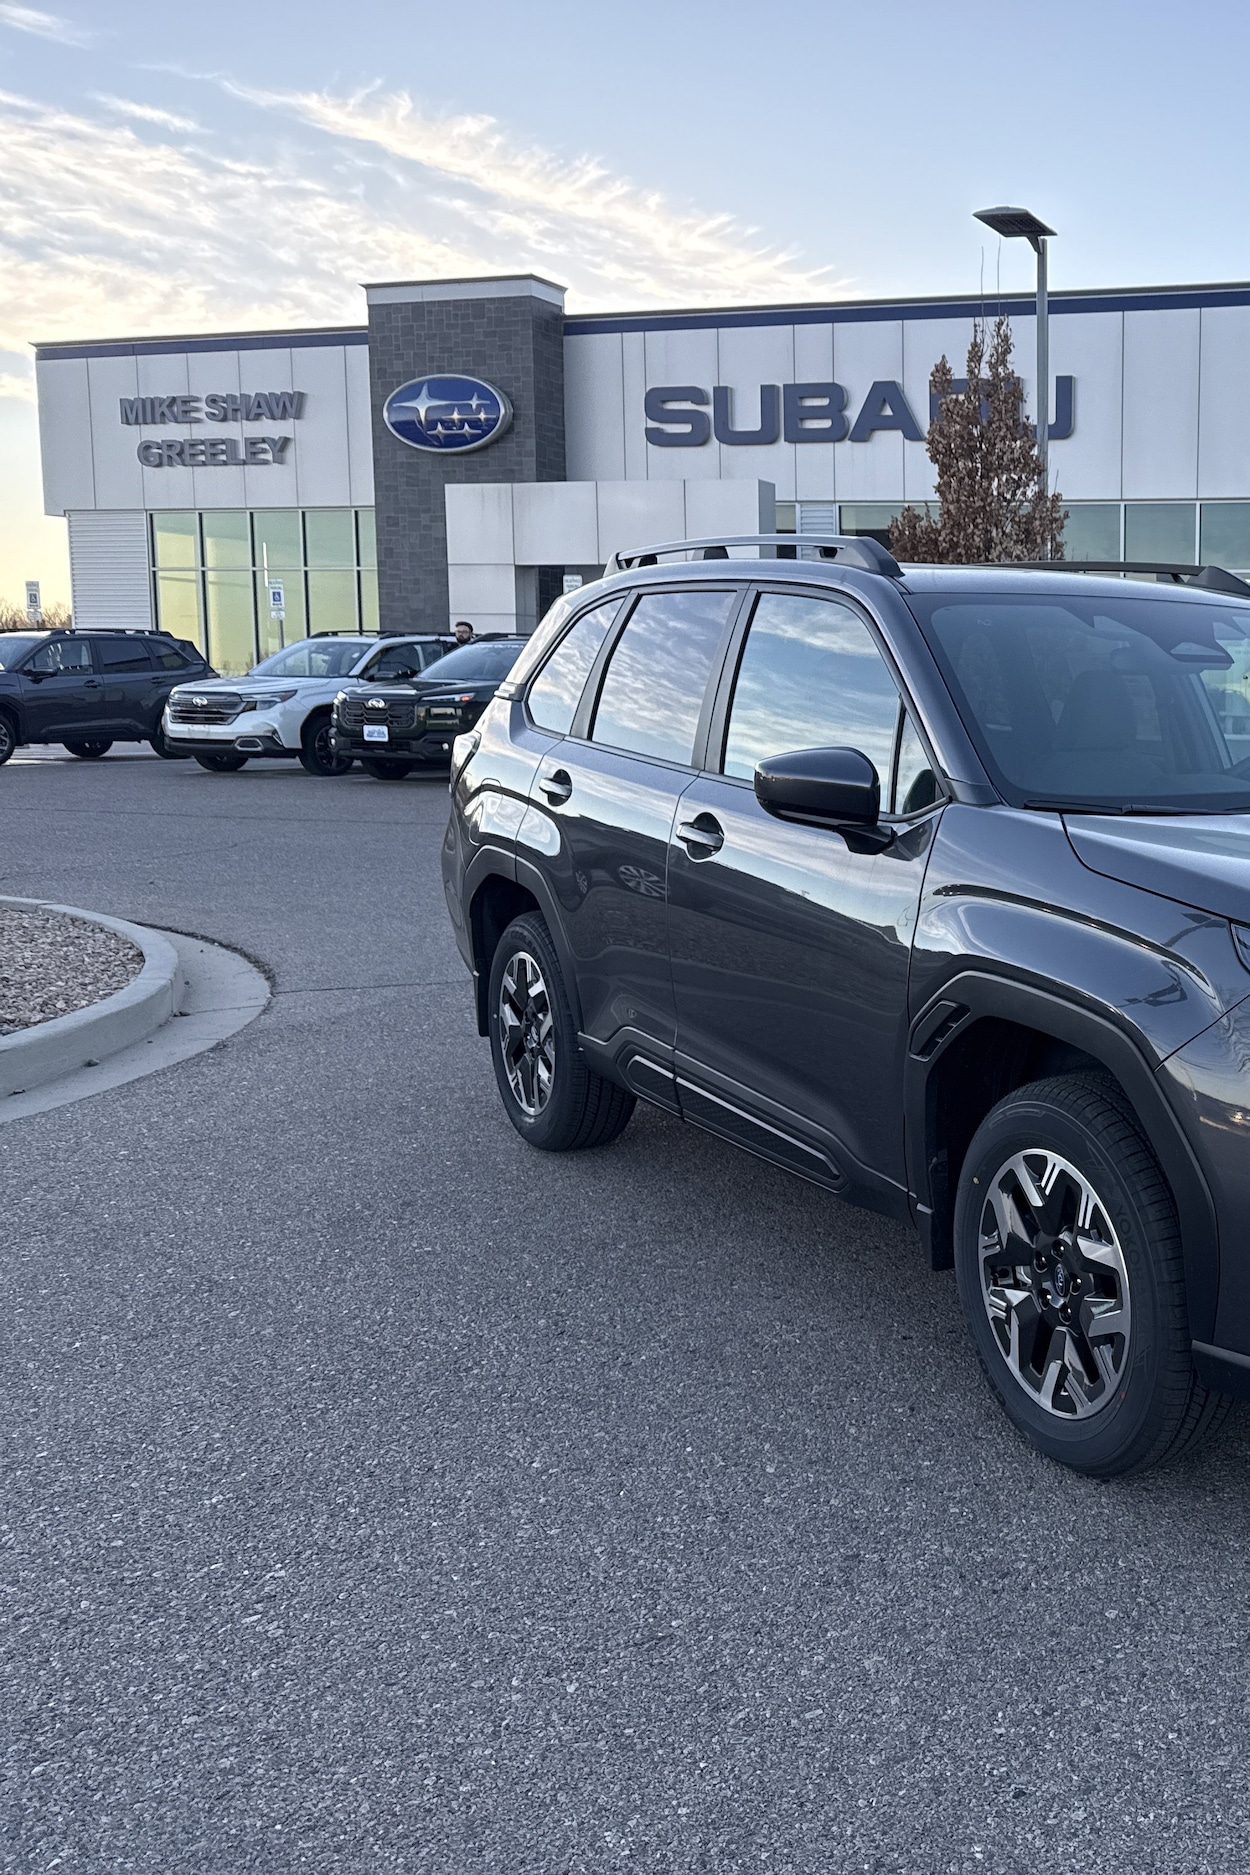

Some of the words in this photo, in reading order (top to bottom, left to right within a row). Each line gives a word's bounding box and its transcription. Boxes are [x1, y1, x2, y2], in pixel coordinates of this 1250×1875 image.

[120, 396, 202, 425] MIKE
[205, 391, 305, 421] SHAW
[137, 436, 291, 467] GREELEY
